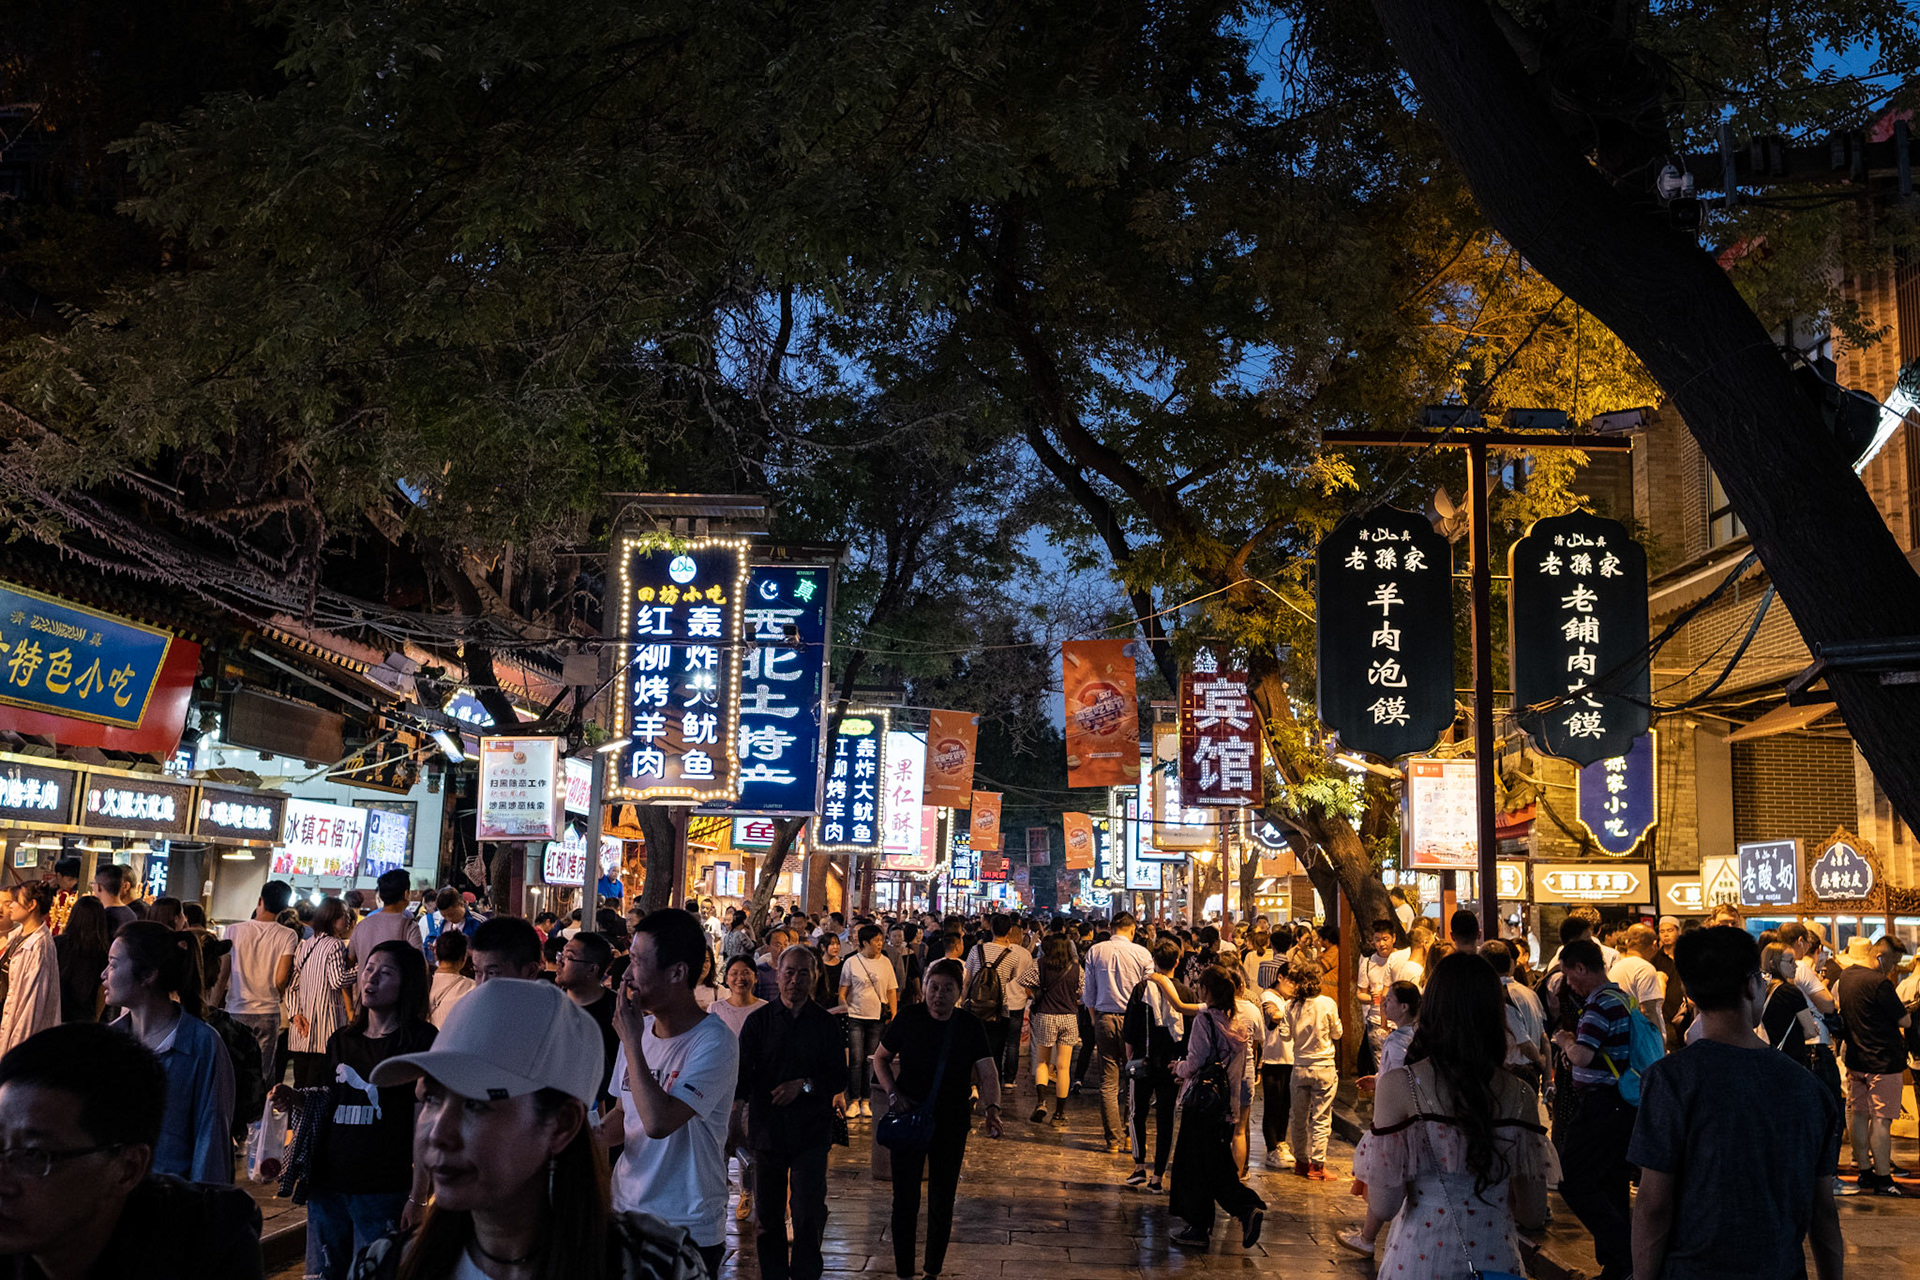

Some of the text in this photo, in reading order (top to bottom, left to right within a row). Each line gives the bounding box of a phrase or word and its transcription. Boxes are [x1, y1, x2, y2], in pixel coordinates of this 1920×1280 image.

[1359, 529, 1370, 541] 清
[1400, 530, 1412, 542] 真
[1554, 534, 1565, 547] 清
[1595, 535, 1607, 547] 真
[1344, 545, 1428, 573] 老孫家
[1539, 550, 1624, 579] 老孫家
[637, 584, 727, 606] 回坊小吃
[794, 578, 817, 602] 真
[89, 632, 104, 648] 真
[631, 604, 673, 779] 红柳烤羊肉
[679, 604, 722, 780] 轰炸大鱿鱼
[737, 607, 805, 797] 西北土特产
[1192, 677, 1255, 792] 宾馆
[852, 737, 877, 843] 轰炸大鱿鱼
[891, 758, 915, 834] 果仁酥
[284, 812, 359, 849] 冰镇石榴汁
[546, 849, 586, 880] 红柳烤肉
[1742, 858, 1794, 894] 老酸奶
